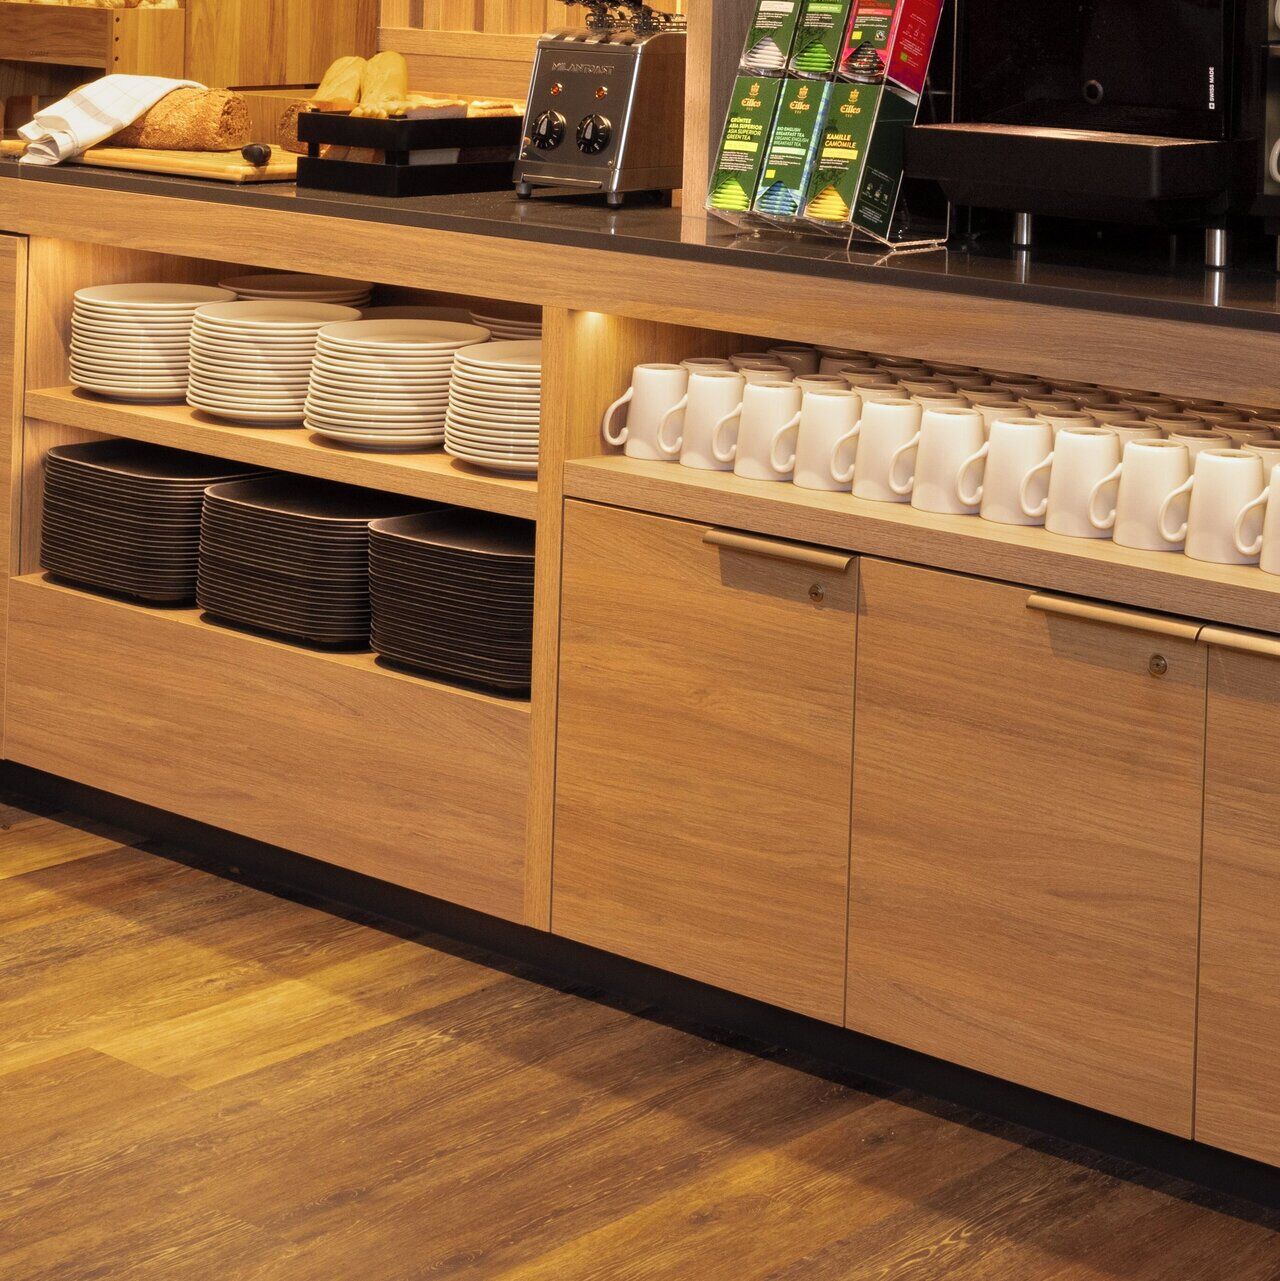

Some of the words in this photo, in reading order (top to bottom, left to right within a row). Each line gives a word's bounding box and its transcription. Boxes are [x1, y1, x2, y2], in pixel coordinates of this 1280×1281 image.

[551, 62, 615, 75] MILANTOAST
[741, 97, 762, 108] Eilles
[789, 100, 810, 110] Eilles
[840, 104, 861, 114] Eilles
[739, 123, 763, 131] SUPERIOR
[737, 128, 762, 136] SUPERIOR
[826, 133, 852, 141] KAMILLE
[824, 140, 857, 149] CAMOMILE
